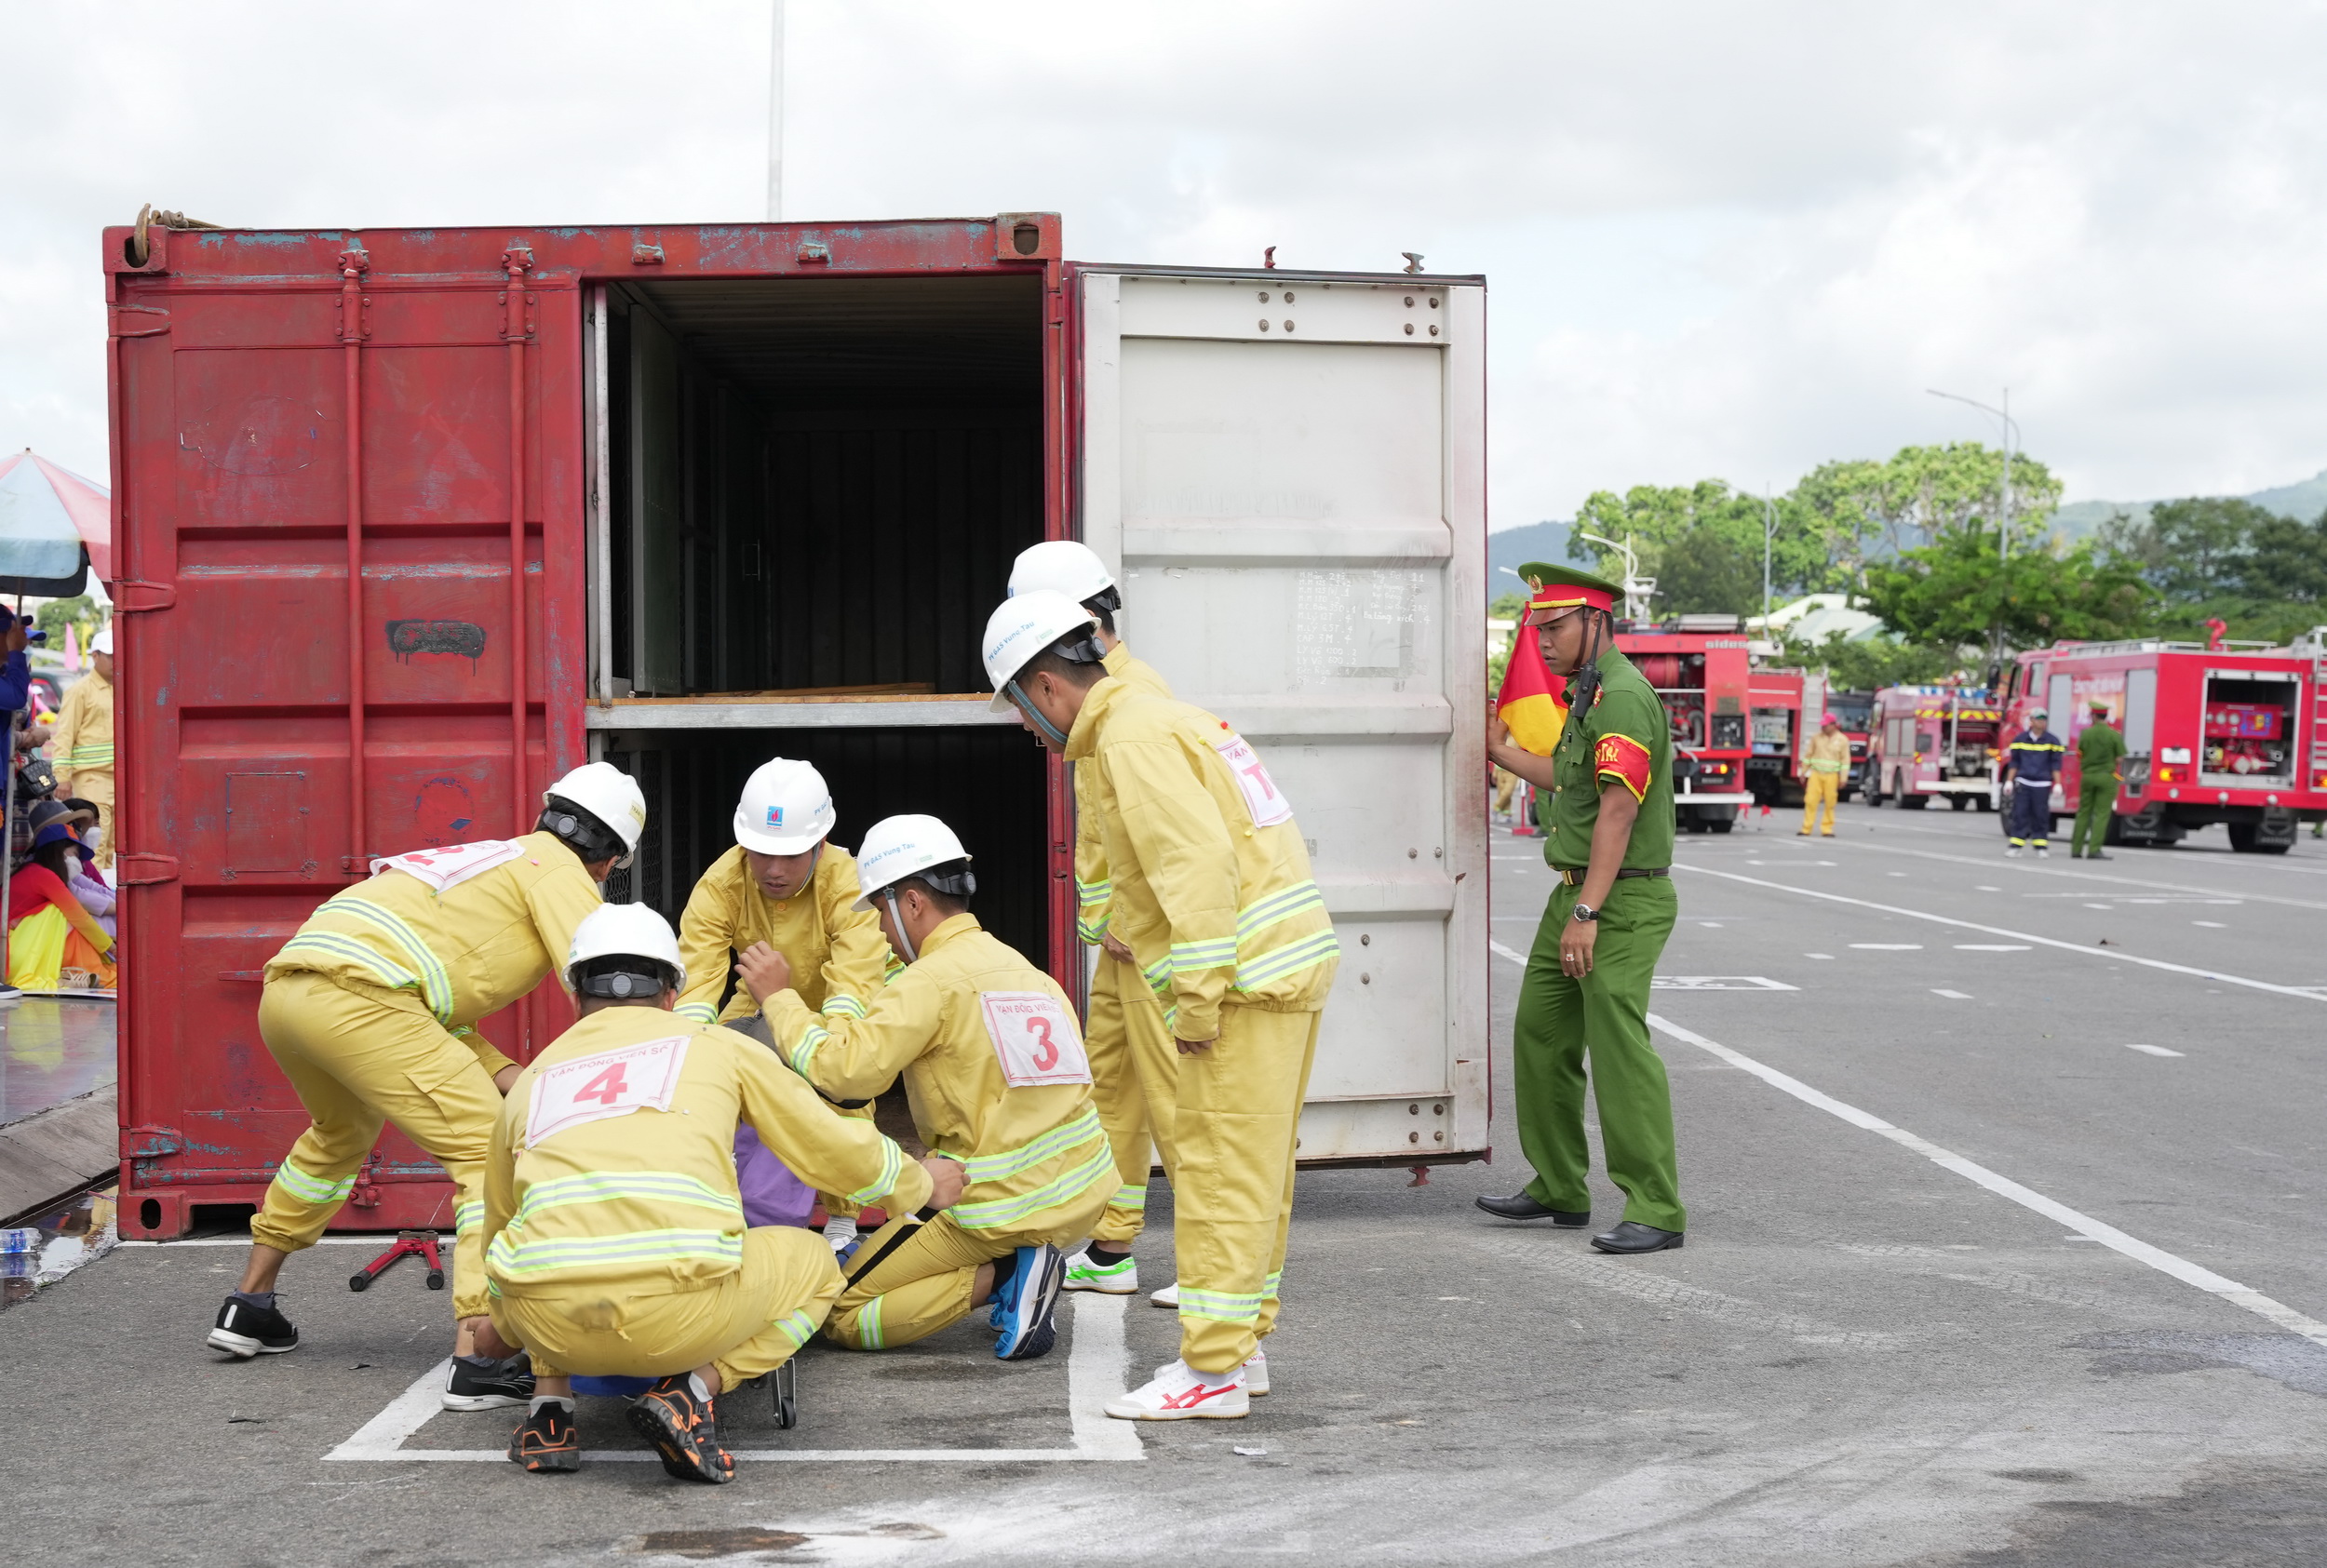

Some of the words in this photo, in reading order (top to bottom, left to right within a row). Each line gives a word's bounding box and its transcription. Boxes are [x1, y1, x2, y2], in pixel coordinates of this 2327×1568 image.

[1705, 639, 1748, 649] sides
[1027, 1016, 1059, 1071] 3
[573, 1062, 628, 1104] 4
